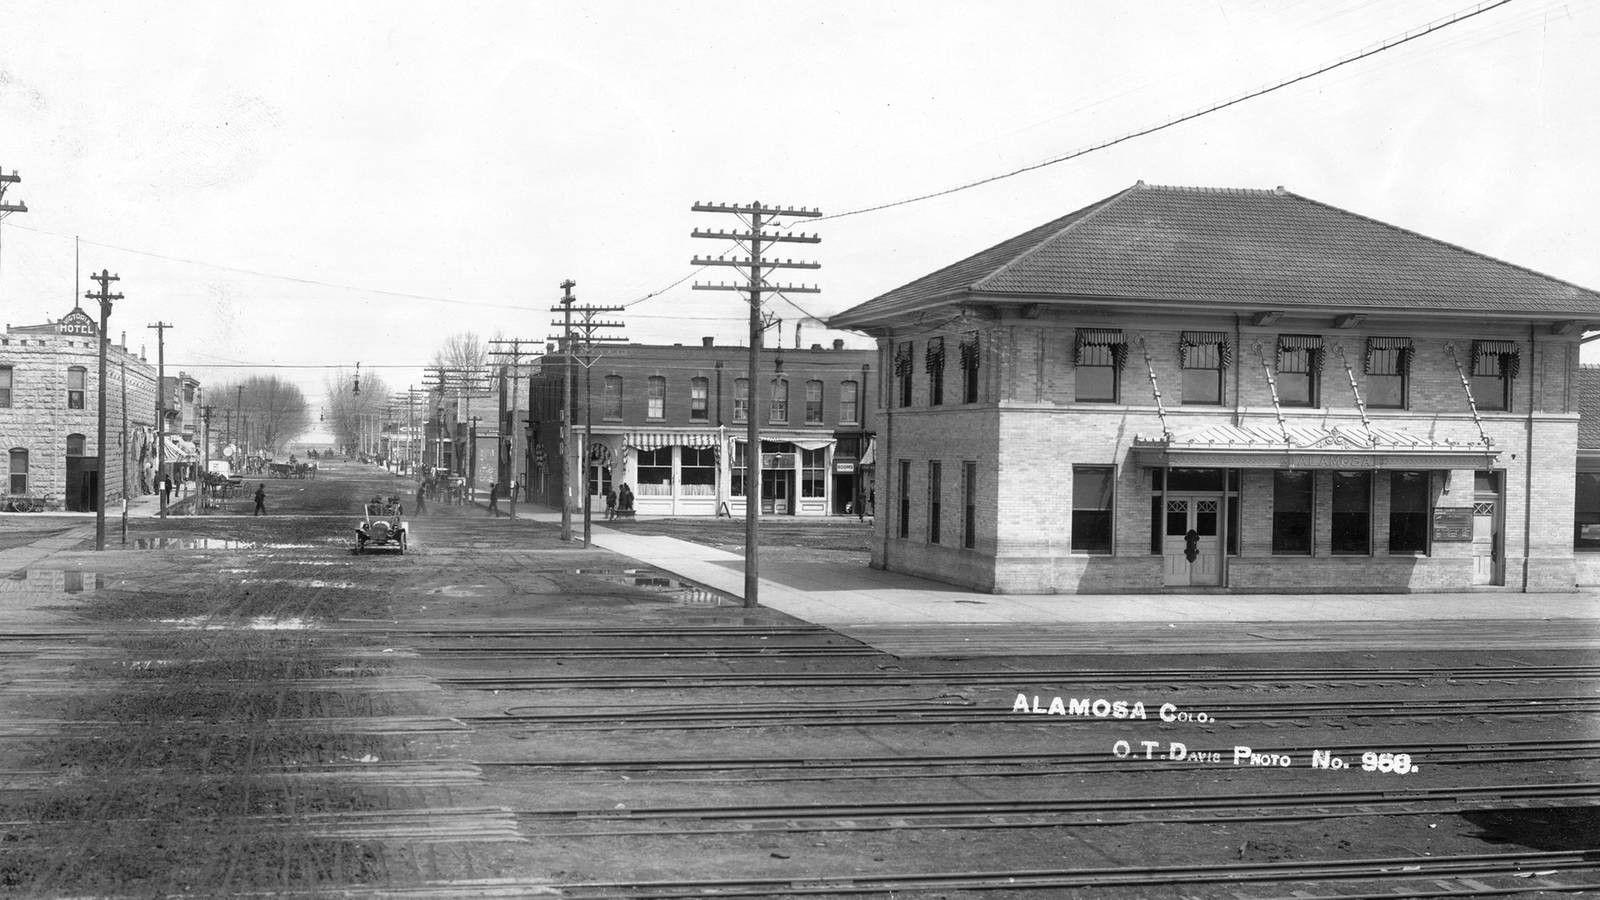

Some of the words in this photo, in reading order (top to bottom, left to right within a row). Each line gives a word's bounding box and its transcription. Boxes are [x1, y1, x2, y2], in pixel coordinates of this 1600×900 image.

[63, 313, 91, 325] VICTORIA
[60, 324, 94, 334] HOTEL
[1299, 455, 1371, 467] ALAMOSA
